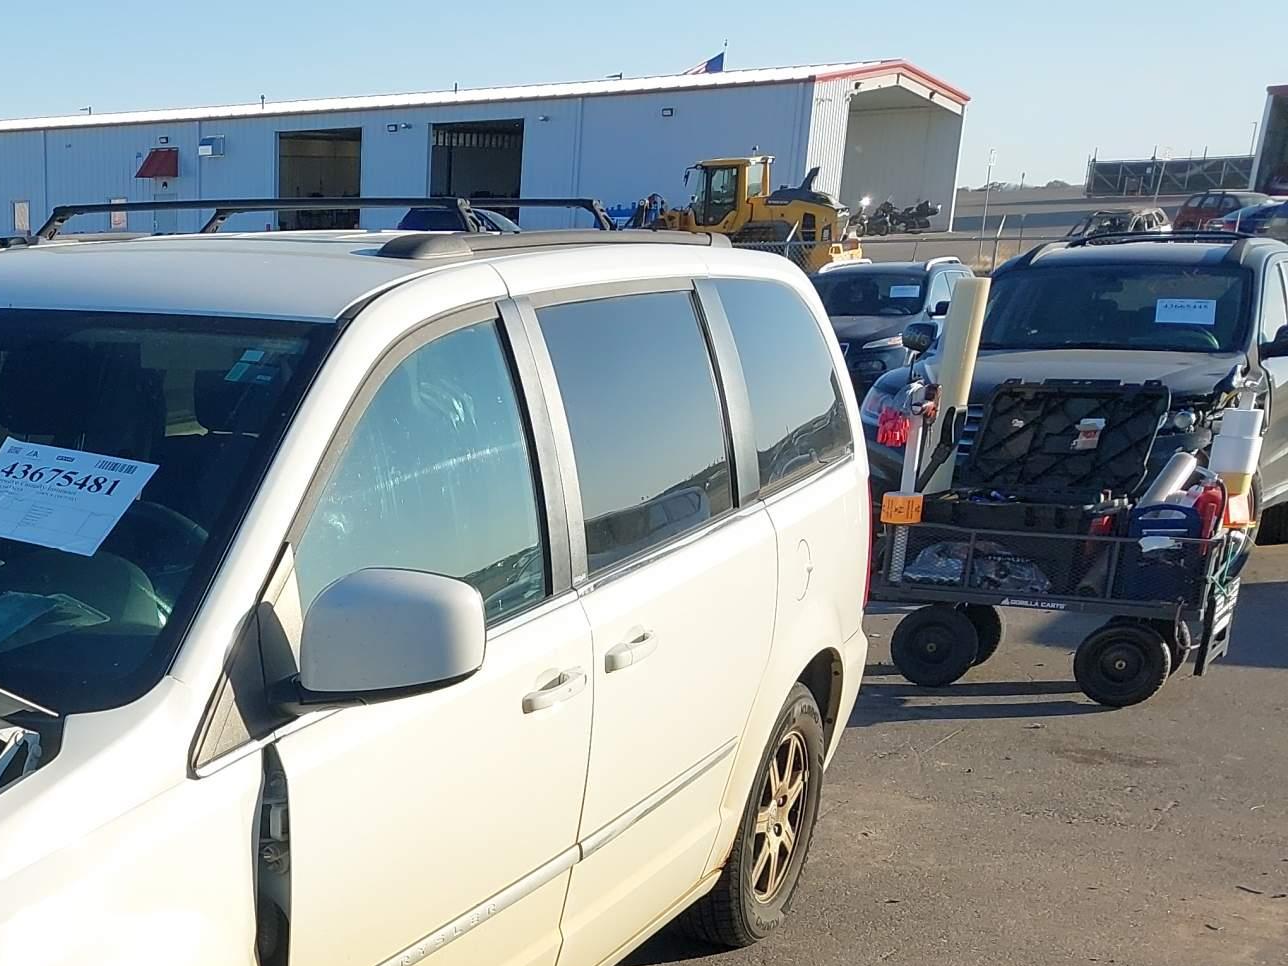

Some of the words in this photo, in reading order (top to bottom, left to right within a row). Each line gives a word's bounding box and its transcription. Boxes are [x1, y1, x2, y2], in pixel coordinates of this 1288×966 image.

[0, 461, 121, 497] 43675481
[1010, 599, 1039, 608] GORILLA
[1040, 602, 1066, 610] CARTS
